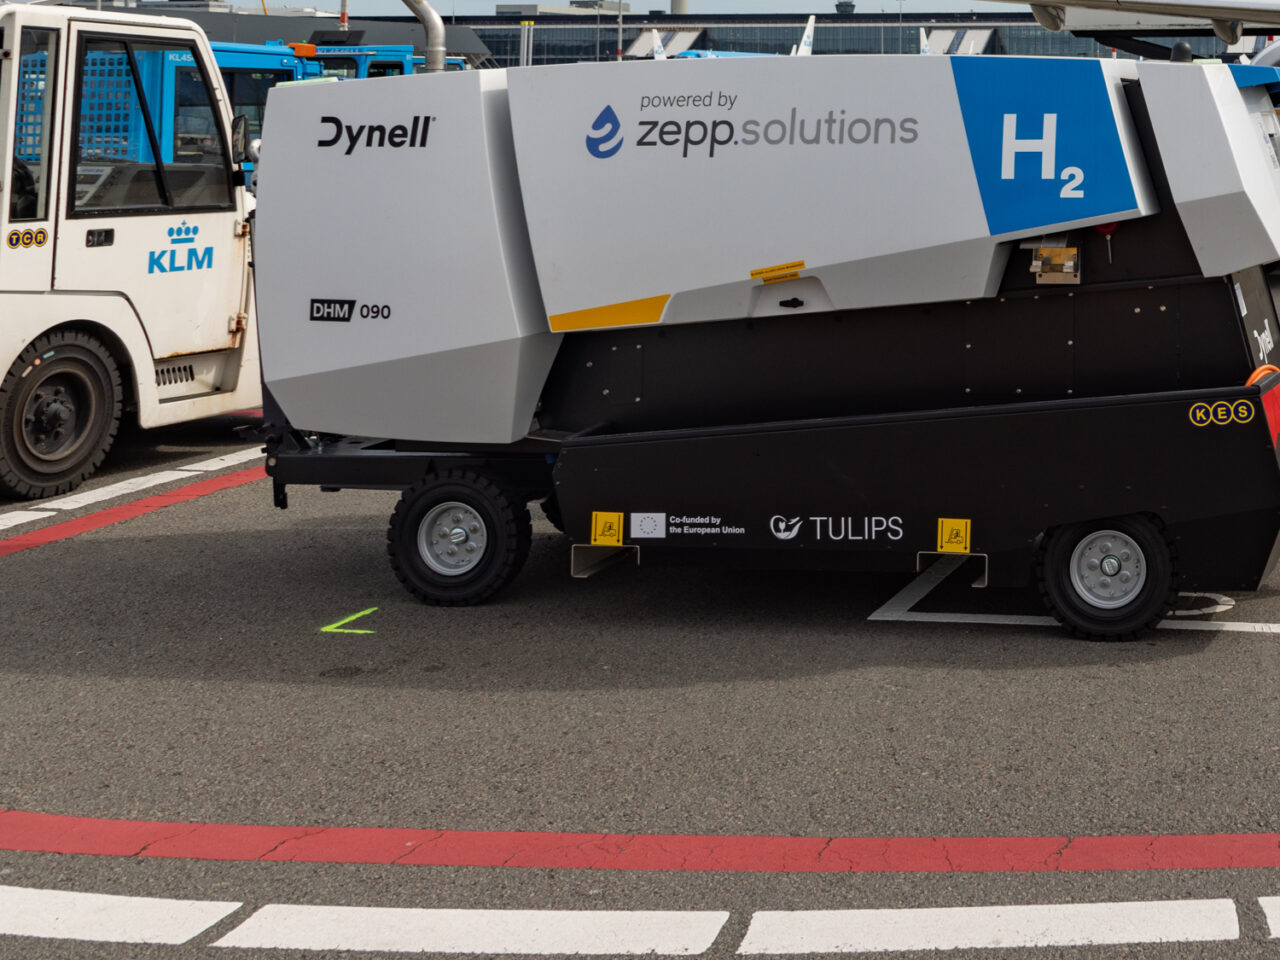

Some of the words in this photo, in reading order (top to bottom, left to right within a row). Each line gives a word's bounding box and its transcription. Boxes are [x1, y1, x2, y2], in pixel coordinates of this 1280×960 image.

[168, 53, 194, 62] KL45
[640, 92, 713, 111] powered
[717, 91, 738, 110] by
[317, 116, 431, 155] Dynell
[636, 107, 919, 158] zepp.solutions
[9, 230, 46, 247] TCR
[147, 246, 214, 274] KLM
[312, 302, 350, 319] DHM
[360, 304, 391, 319] 090
[1192, 403, 1250, 423] KES
[669, 515, 710, 525] Co-funded
[711, 515, 722, 526] by
[809, 516, 904, 540] TULIPS
[669, 526, 682, 534] the
[683, 526, 721, 536] European
[722, 526, 745, 534] Union
